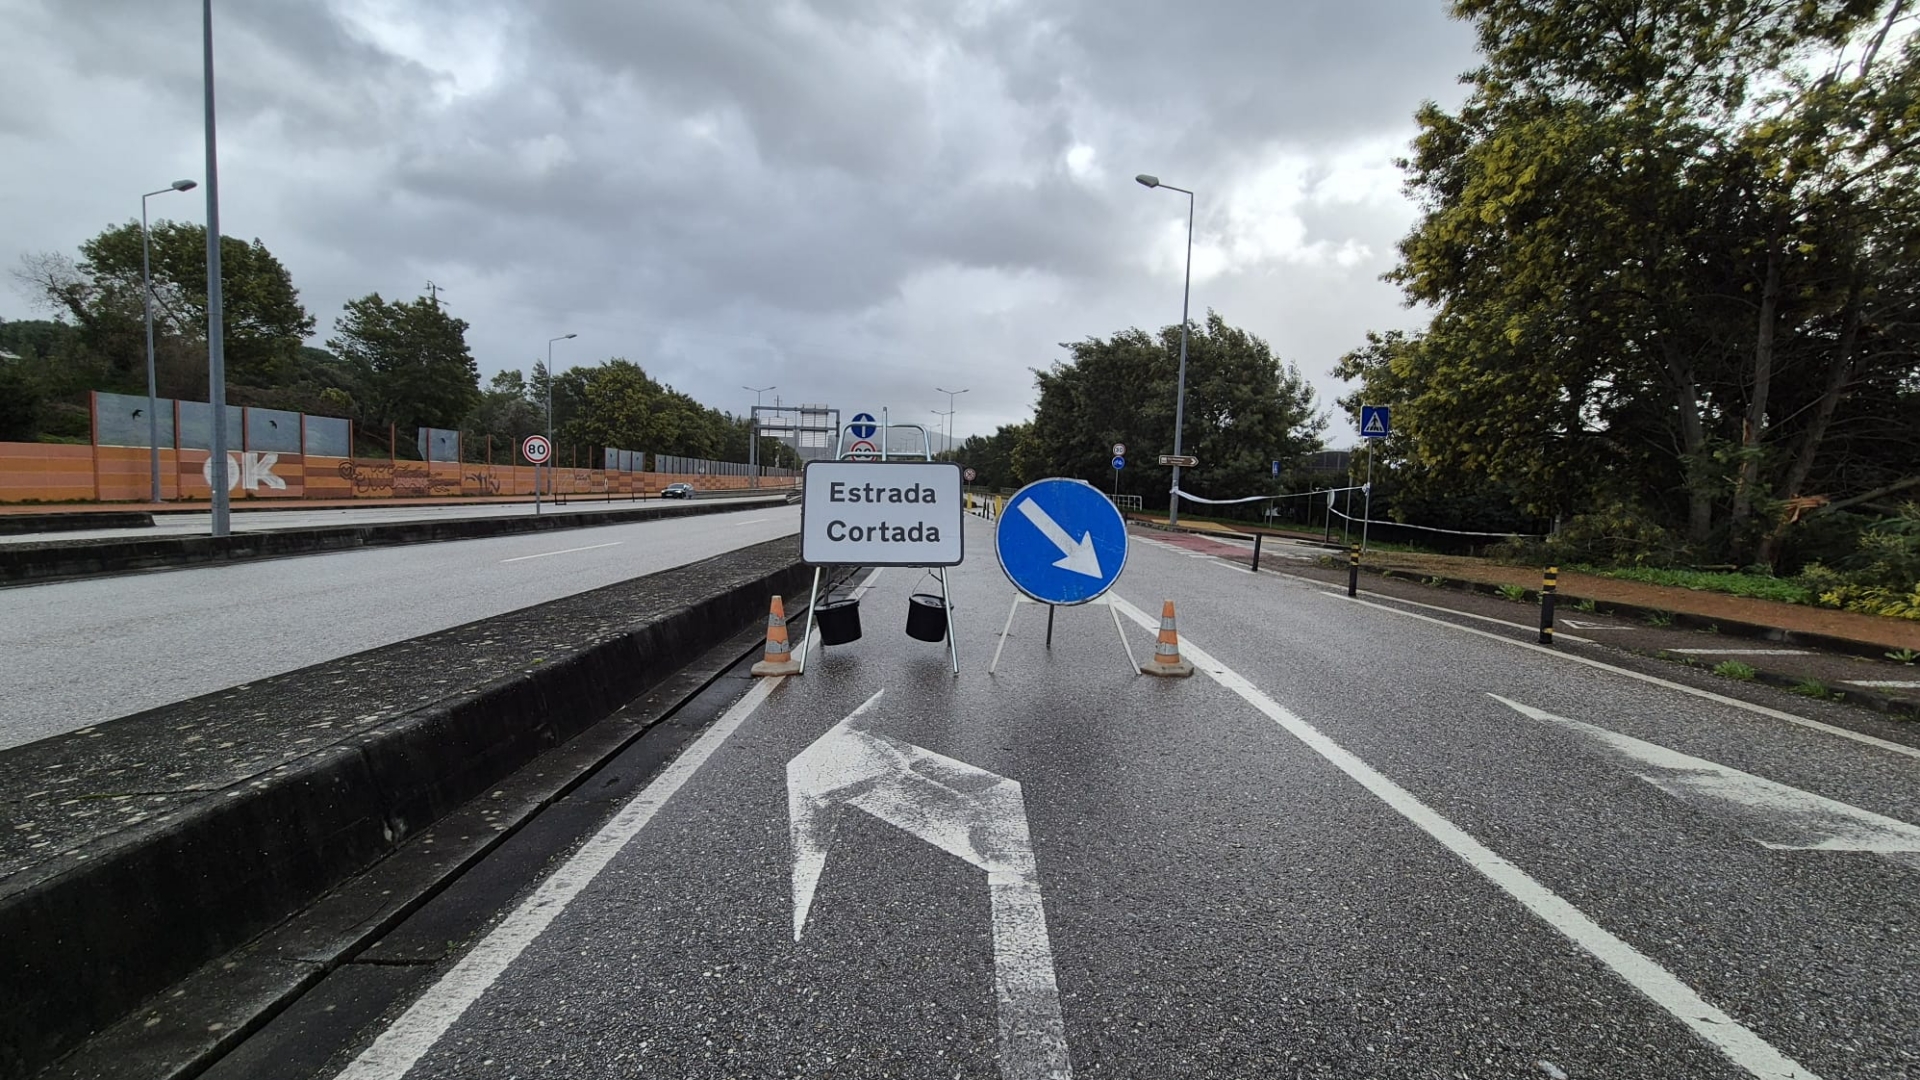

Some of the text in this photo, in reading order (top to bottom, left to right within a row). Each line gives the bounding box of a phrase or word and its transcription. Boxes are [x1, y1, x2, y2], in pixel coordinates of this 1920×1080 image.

[528, 444, 546, 455] 80
[203, 451, 287, 491] OK
[829, 481, 937, 504] Estrada
[826, 519, 941, 543] Cortada
